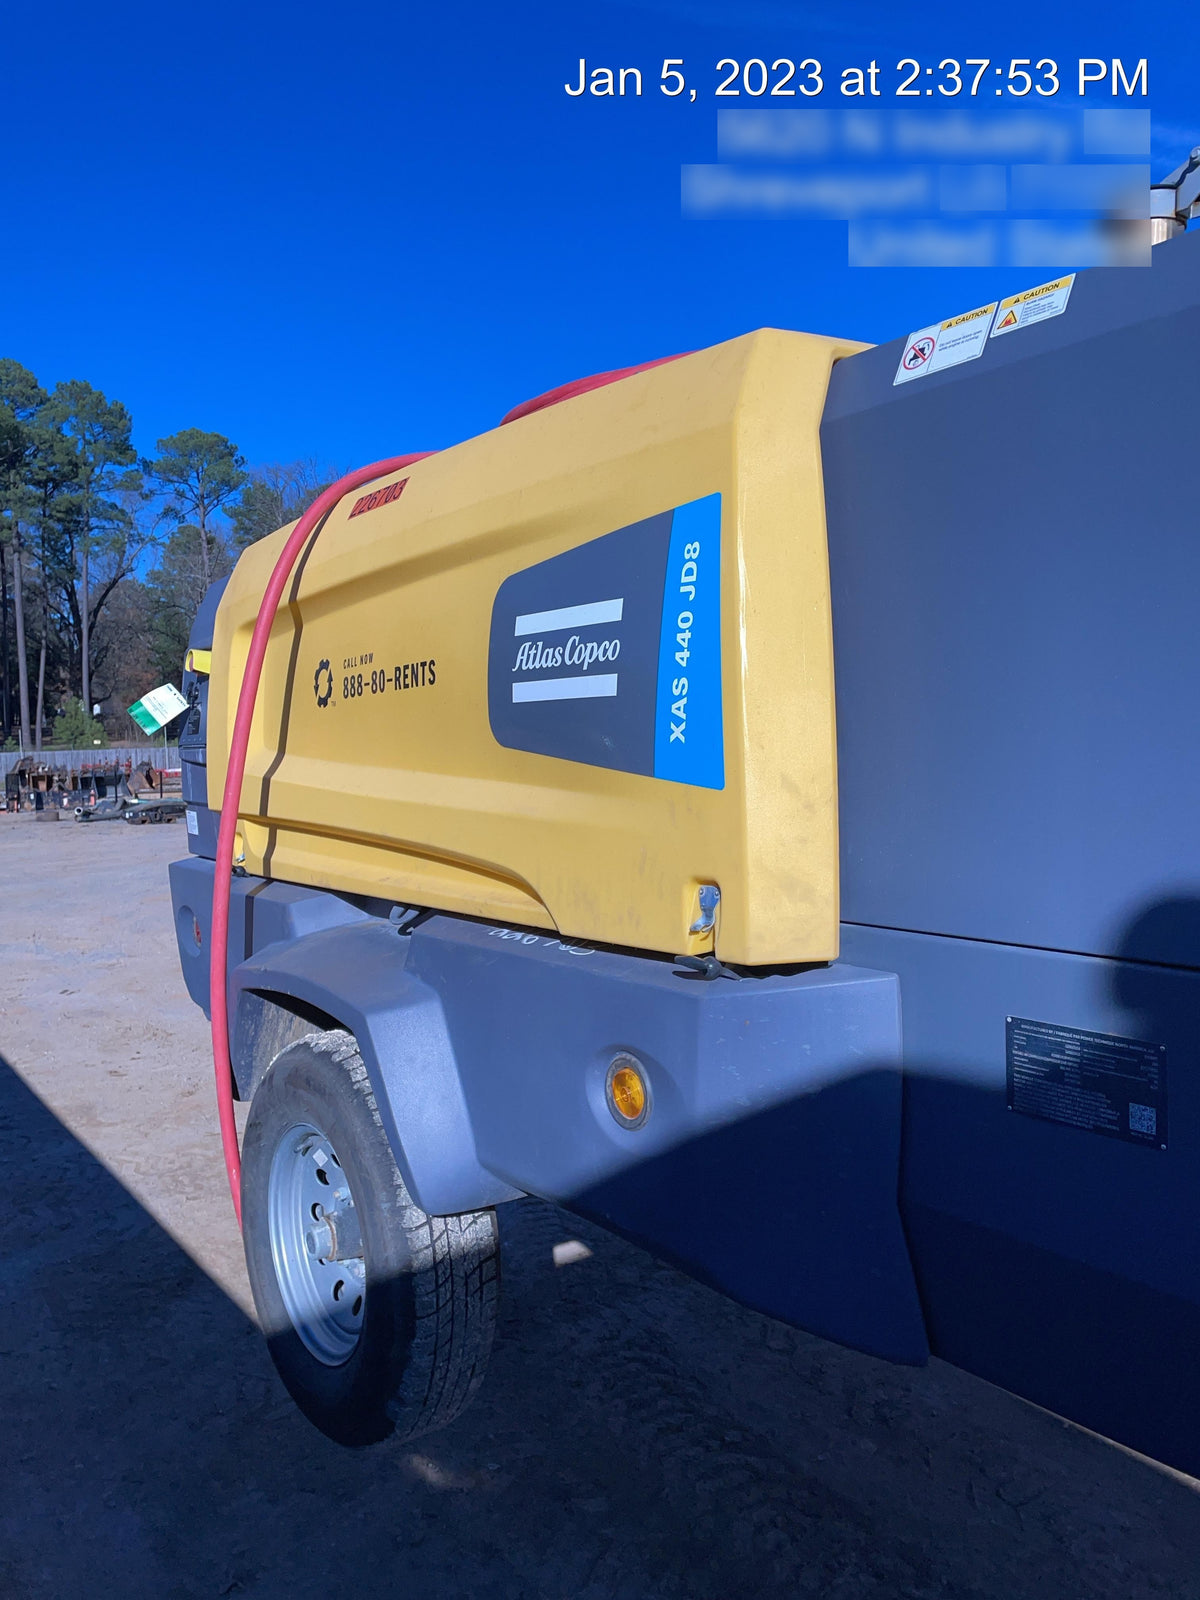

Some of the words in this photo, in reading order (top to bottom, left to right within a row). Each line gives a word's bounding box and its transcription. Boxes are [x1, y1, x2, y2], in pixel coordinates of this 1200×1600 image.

[1024, 282, 1061, 300] CAUTION
[956, 308, 989, 325] CAUTION
[349, 478, 408, 517] 226703
[679, 540, 701, 602] JD8
[512, 641, 563, 672] Atlas
[564, 635, 621, 671] Copco
[674, 610, 694, 667] 440
[342, 659, 436, 699] 888-80-RENTS
[343, 656, 358, 669] CALL
[360, 652, 374, 666] NOW
[669, 676, 689, 744] XAS
